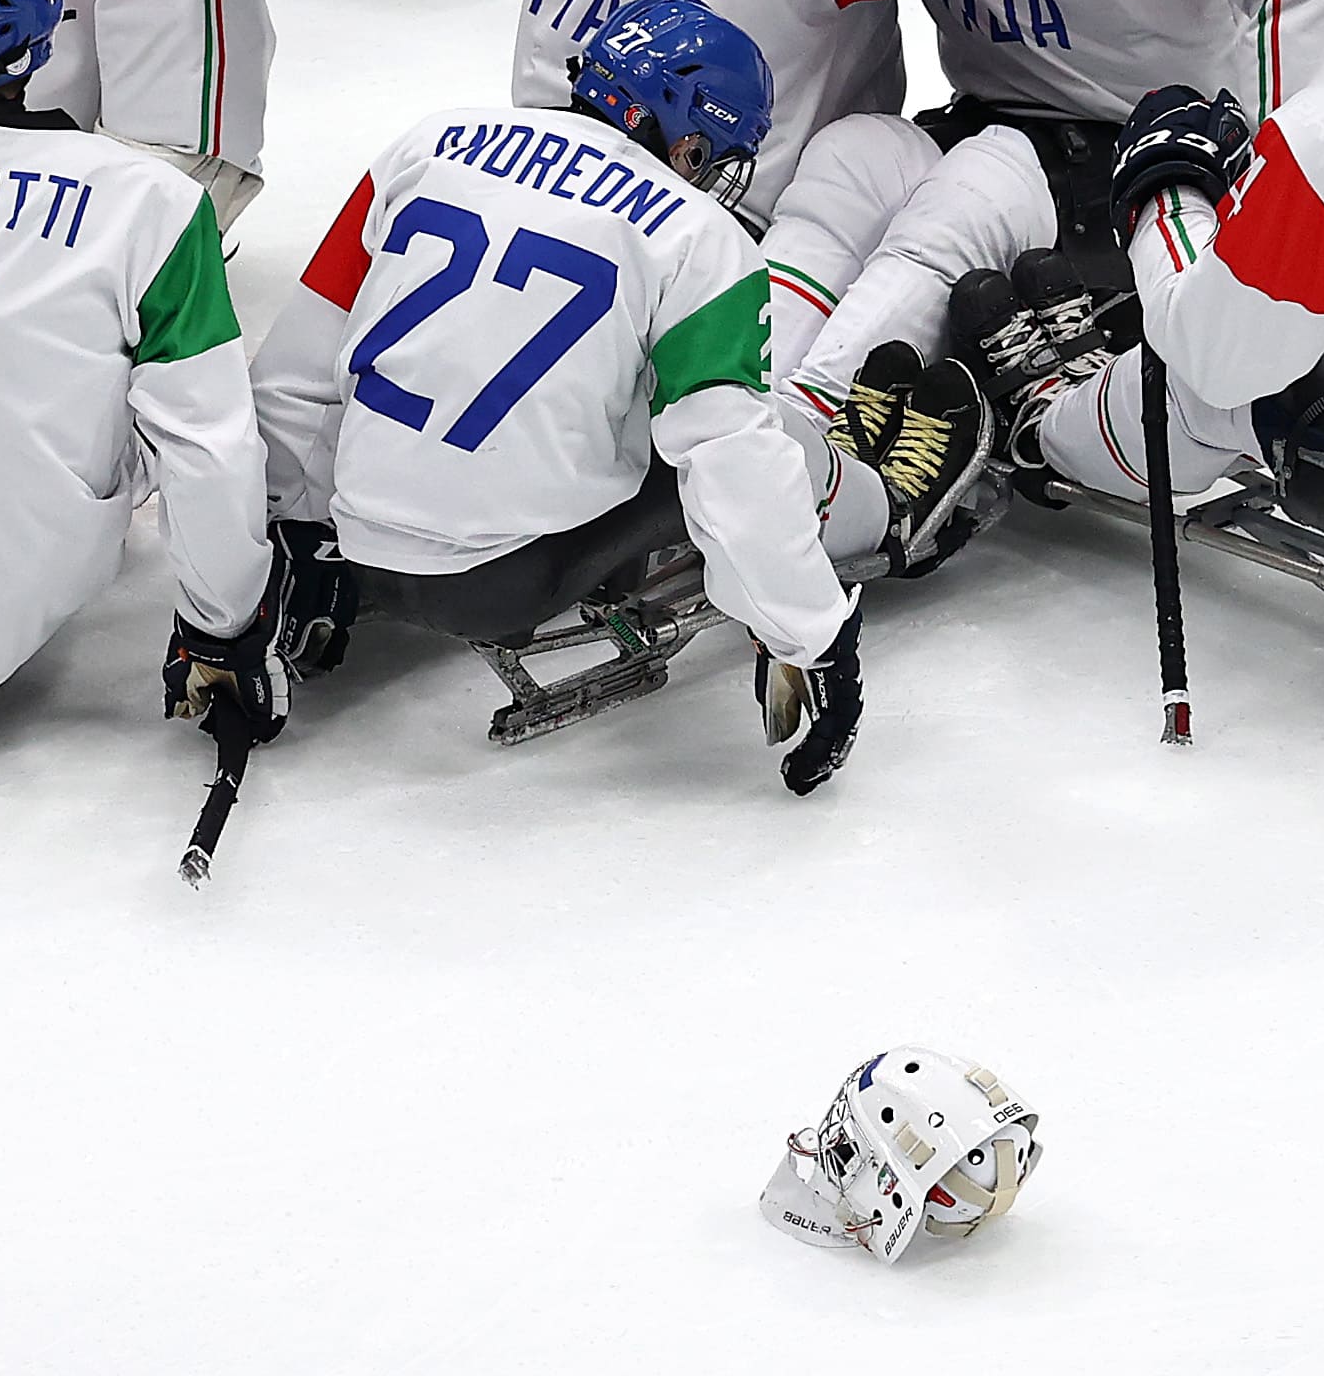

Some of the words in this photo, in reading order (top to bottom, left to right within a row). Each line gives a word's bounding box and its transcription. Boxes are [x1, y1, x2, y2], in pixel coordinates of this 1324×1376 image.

[606, 22, 654, 56] 27
[704, 101, 739, 125] CCM
[348, 195, 619, 454] 27
[884, 1206, 915, 1257] BAUER
